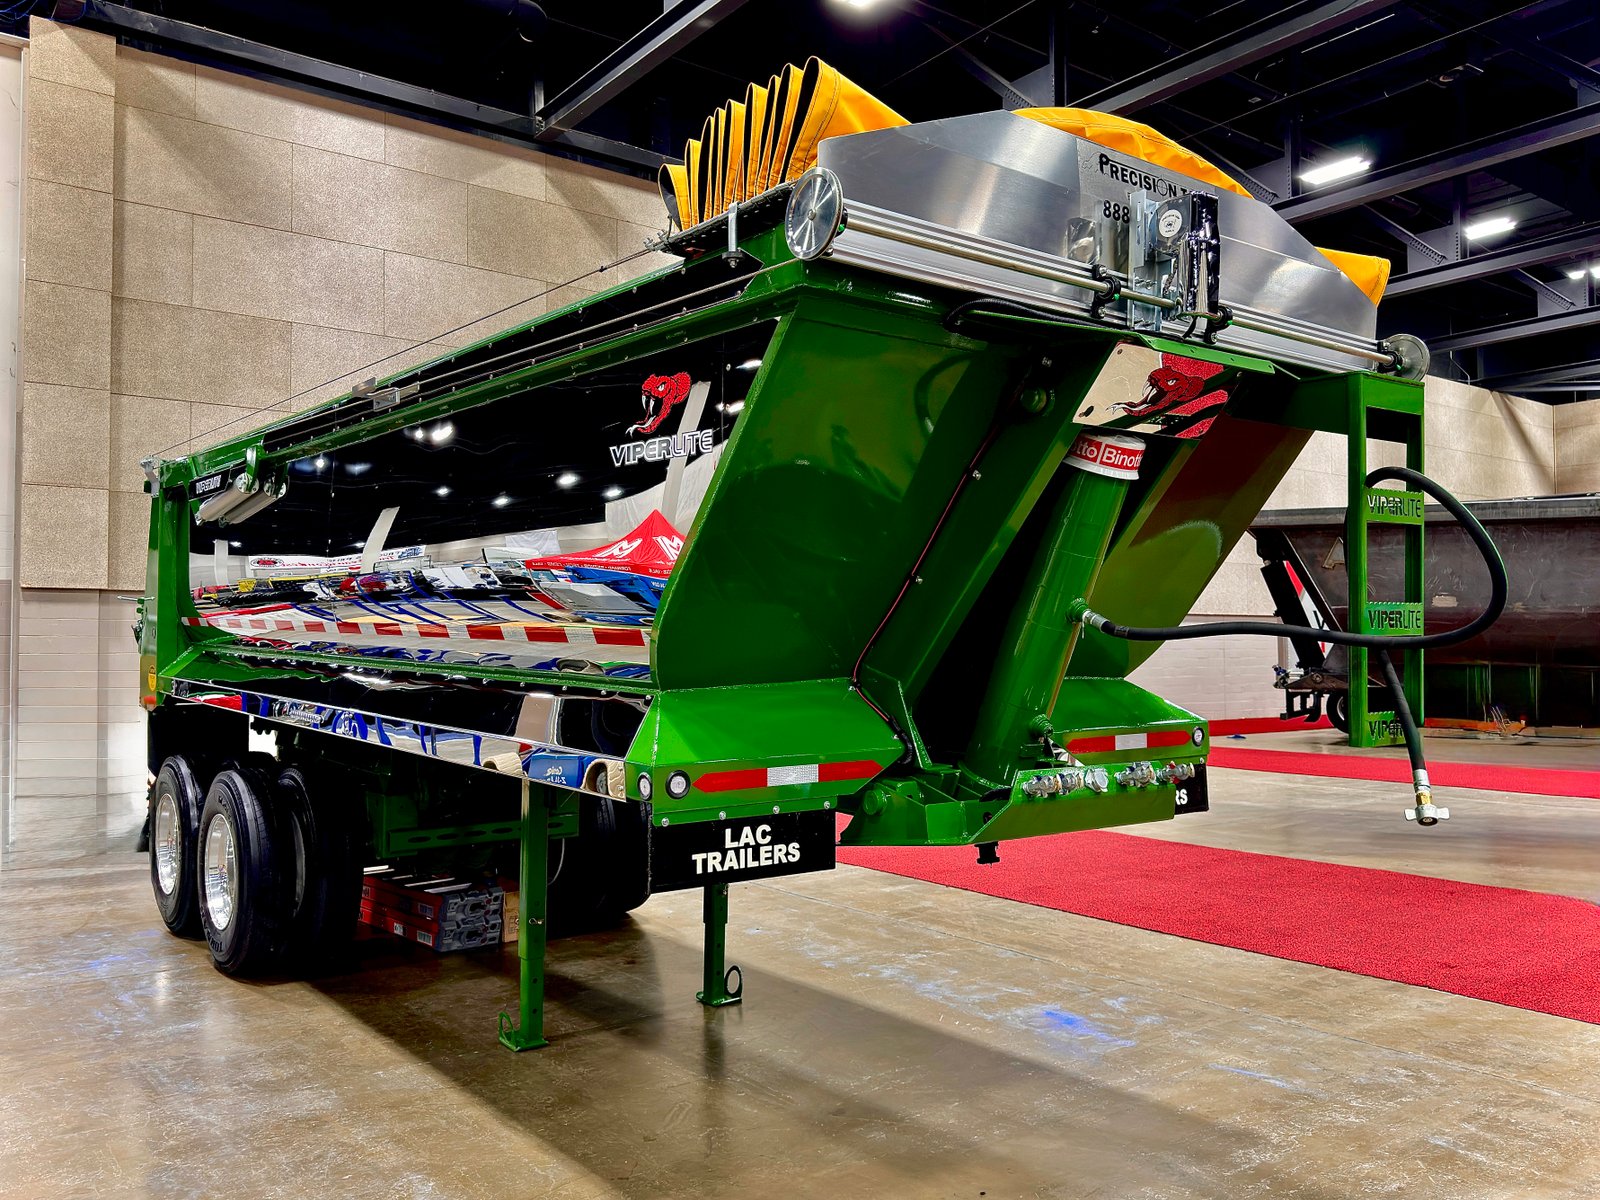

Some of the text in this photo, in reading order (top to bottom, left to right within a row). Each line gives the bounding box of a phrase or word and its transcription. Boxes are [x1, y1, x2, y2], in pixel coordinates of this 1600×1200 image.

[1099, 153, 1177, 198] PRECISION
[1103, 200, 1130, 223] 888
[610, 429, 713, 467] VIPERLITE
[1367, 495, 1421, 518] VIPERLITE
[1367, 610, 1421, 630] VIPERLITE
[724, 824, 772, 849] LAC
[691, 842, 801, 875] TRAILERS
